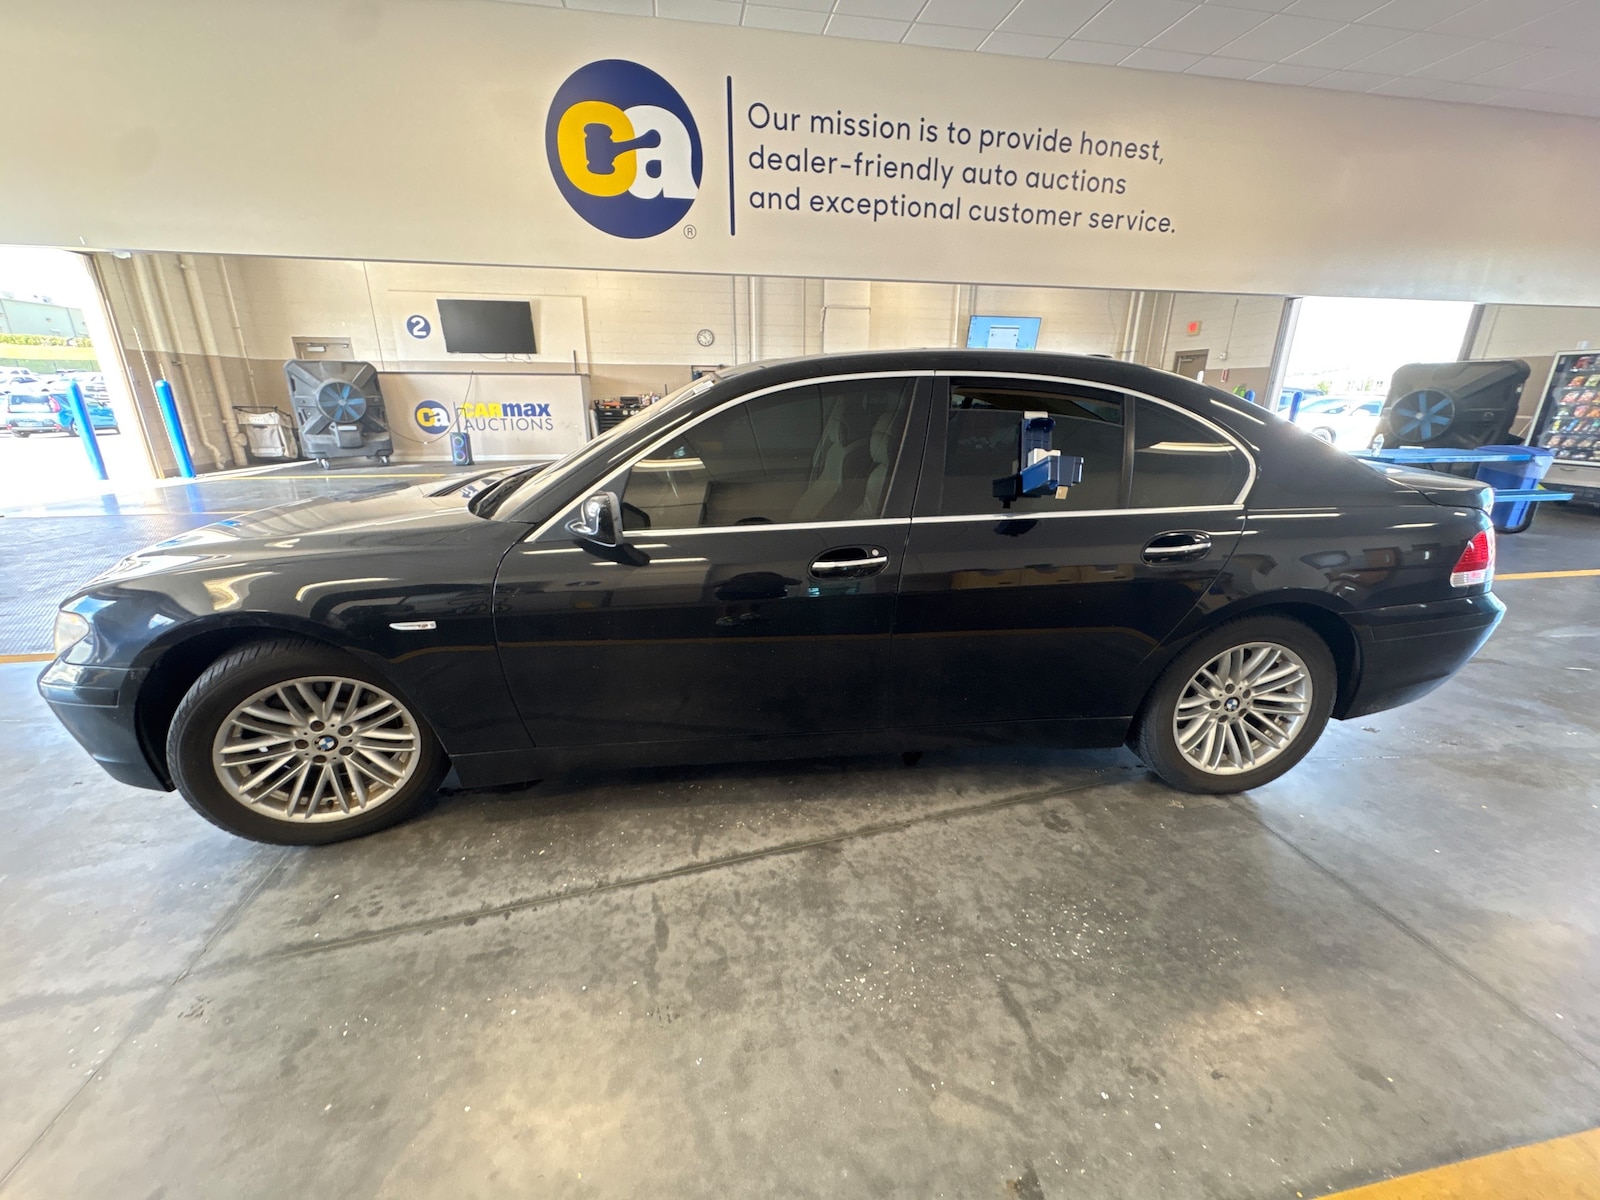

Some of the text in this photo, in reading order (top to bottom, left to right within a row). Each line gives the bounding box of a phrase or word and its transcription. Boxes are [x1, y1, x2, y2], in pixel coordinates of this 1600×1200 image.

[747, 102, 1164, 165] Our mission is to provide honest,
[748, 144, 1126, 195] dealer-friendly auto auctions
[749, 186, 1176, 233] and exceptional customer service.
[411, 316, 427, 336] 2
[464, 418, 554, 431] AUCTIONS
